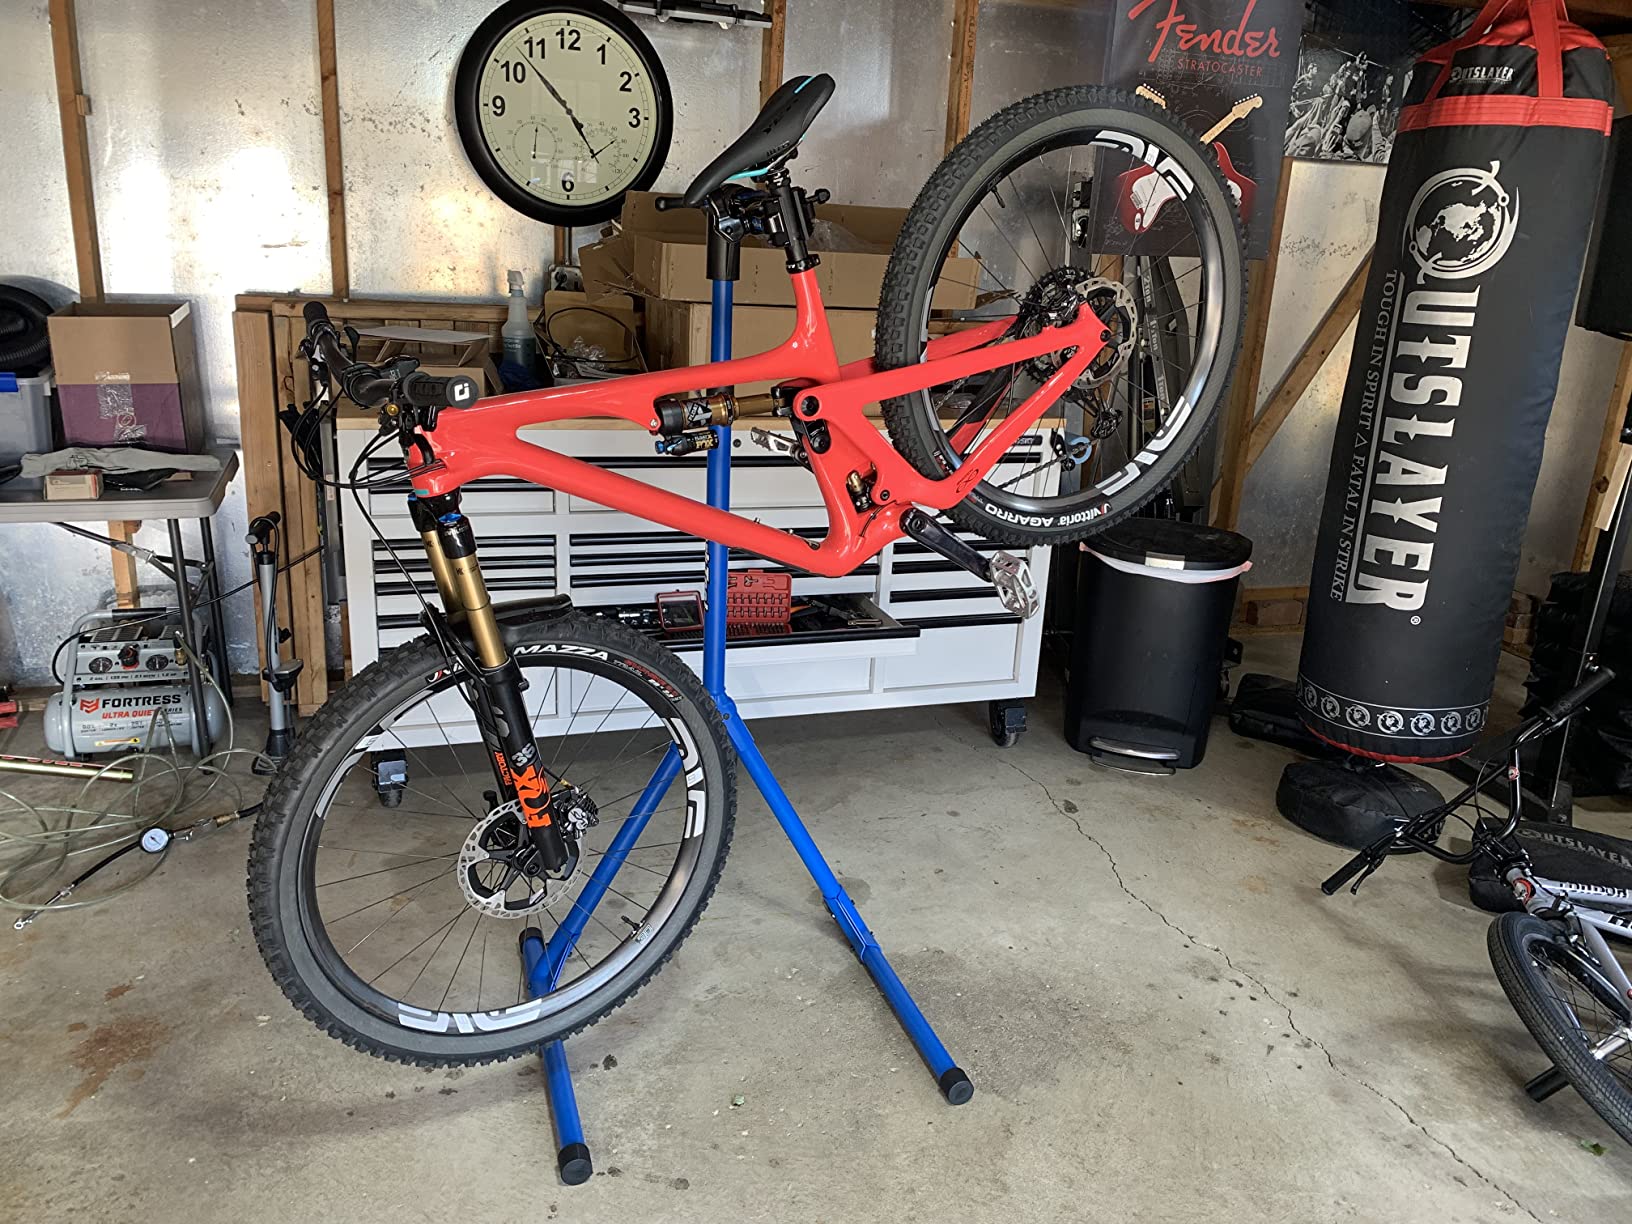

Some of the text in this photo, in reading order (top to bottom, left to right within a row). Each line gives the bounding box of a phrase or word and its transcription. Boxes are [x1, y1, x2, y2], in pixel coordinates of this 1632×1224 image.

[555, 28, 582, 51] 12
[1128, 0, 1280, 63] Fender
[524, 37, 546, 59] 11
[596, 44, 606, 65] 1
[500, 61, 526, 83] 10
[1177, 58, 1263, 77] STRATOCASTER
[619, 71, 632, 92] 2
[492, 95, 506, 117] 9
[628, 107, 641, 128] 3
[561, 172, 575, 193] 6
[696, 439, 713, 449] FOX
[1330, 269, 1398, 602] TOUGH IN SPIRIT FATAL IN STRIKE
[985, 503, 1054, 527] AGARRO
[513, 644, 608, 661] MAZZA
[102, 694, 181, 708] FORTRESS
[102, 710, 130, 719] ULTRA
[512, 743, 535, 767] 36
[510, 765, 552, 829] FOX
